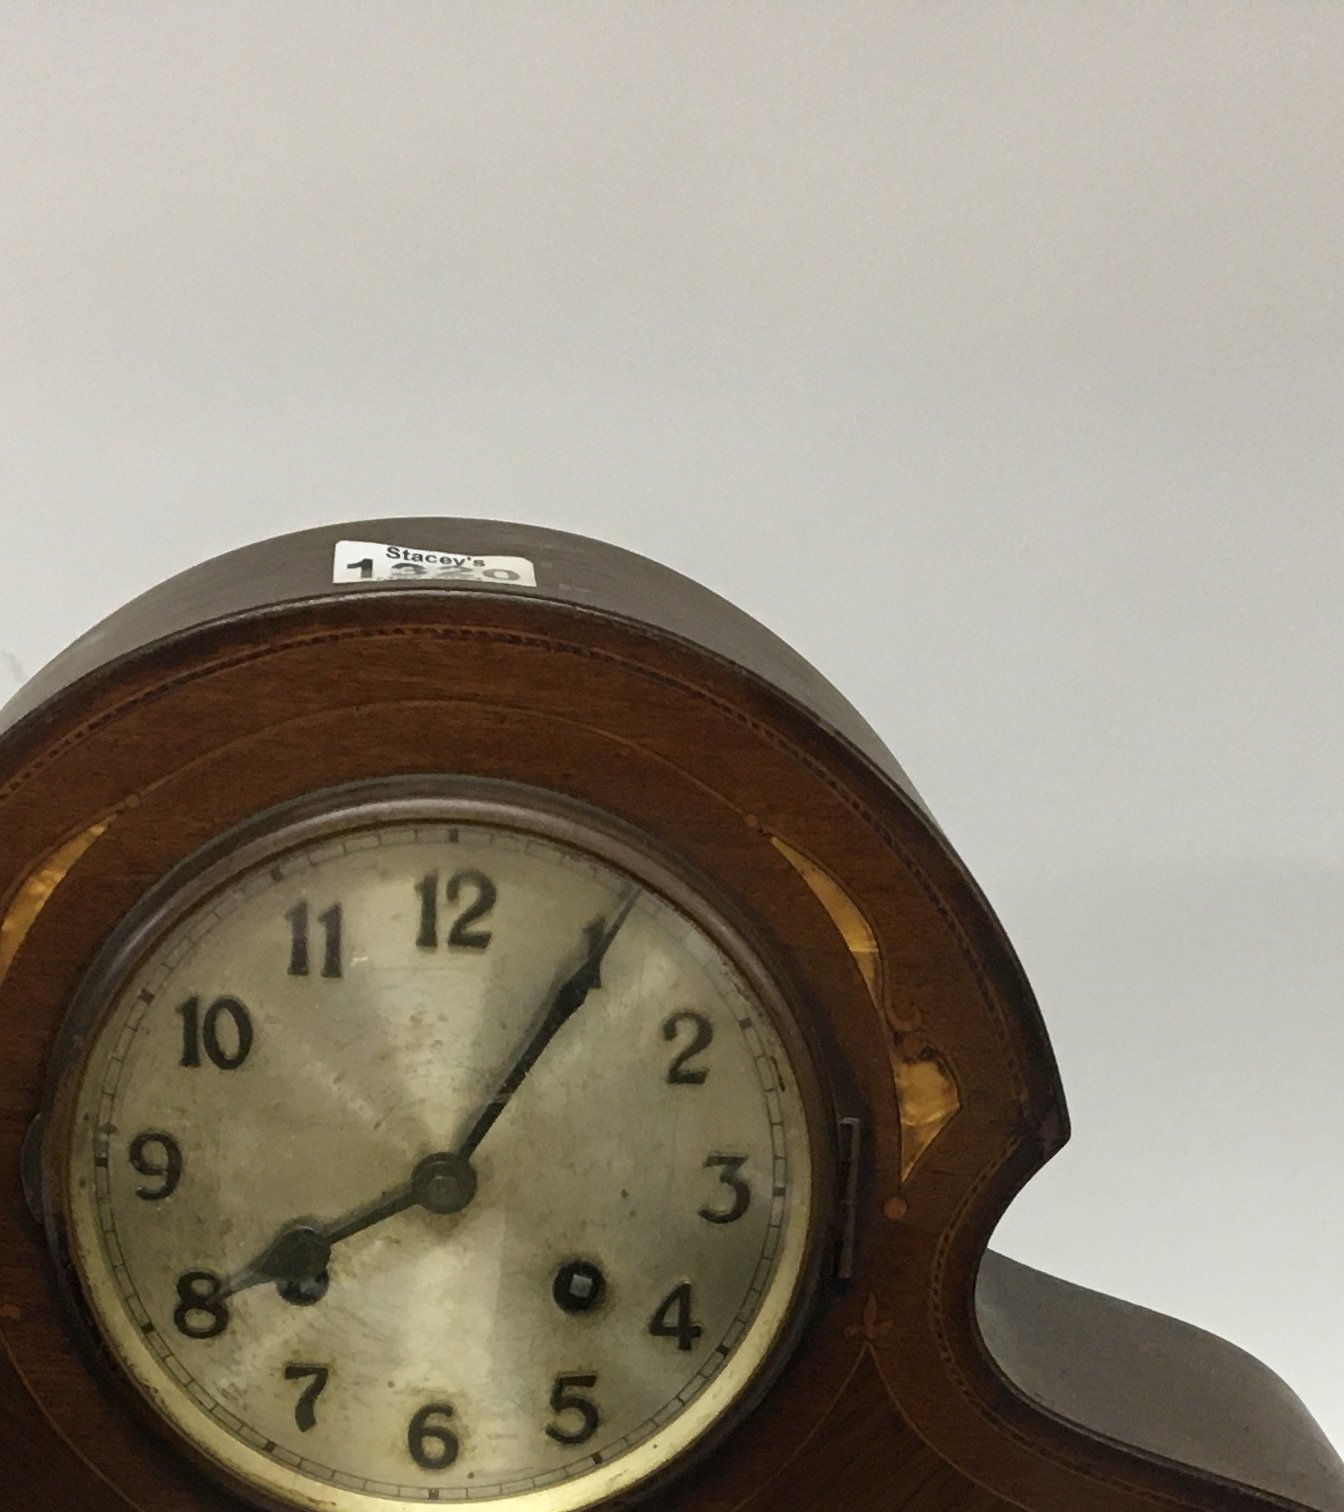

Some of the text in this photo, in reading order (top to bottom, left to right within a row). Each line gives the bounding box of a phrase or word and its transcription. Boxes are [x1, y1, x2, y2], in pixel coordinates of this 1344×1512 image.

[385, 546, 486, 567] Stacey's
[285, 899, 343, 979] 11
[413, 869, 497, 951] 12
[176, 995, 254, 1072] 10
[663, 1011, 714, 1085] 2
[128, 1132, 183, 1202] 9
[698, 1152, 752, 1224] 3
[173, 1270, 229, 1340] 8
[648, 1280, 703, 1351] 4
[283, 1362, 329, 1433] 7
[545, 1375, 599, 1446] 5
[407, 1403, 459, 1471] 6
